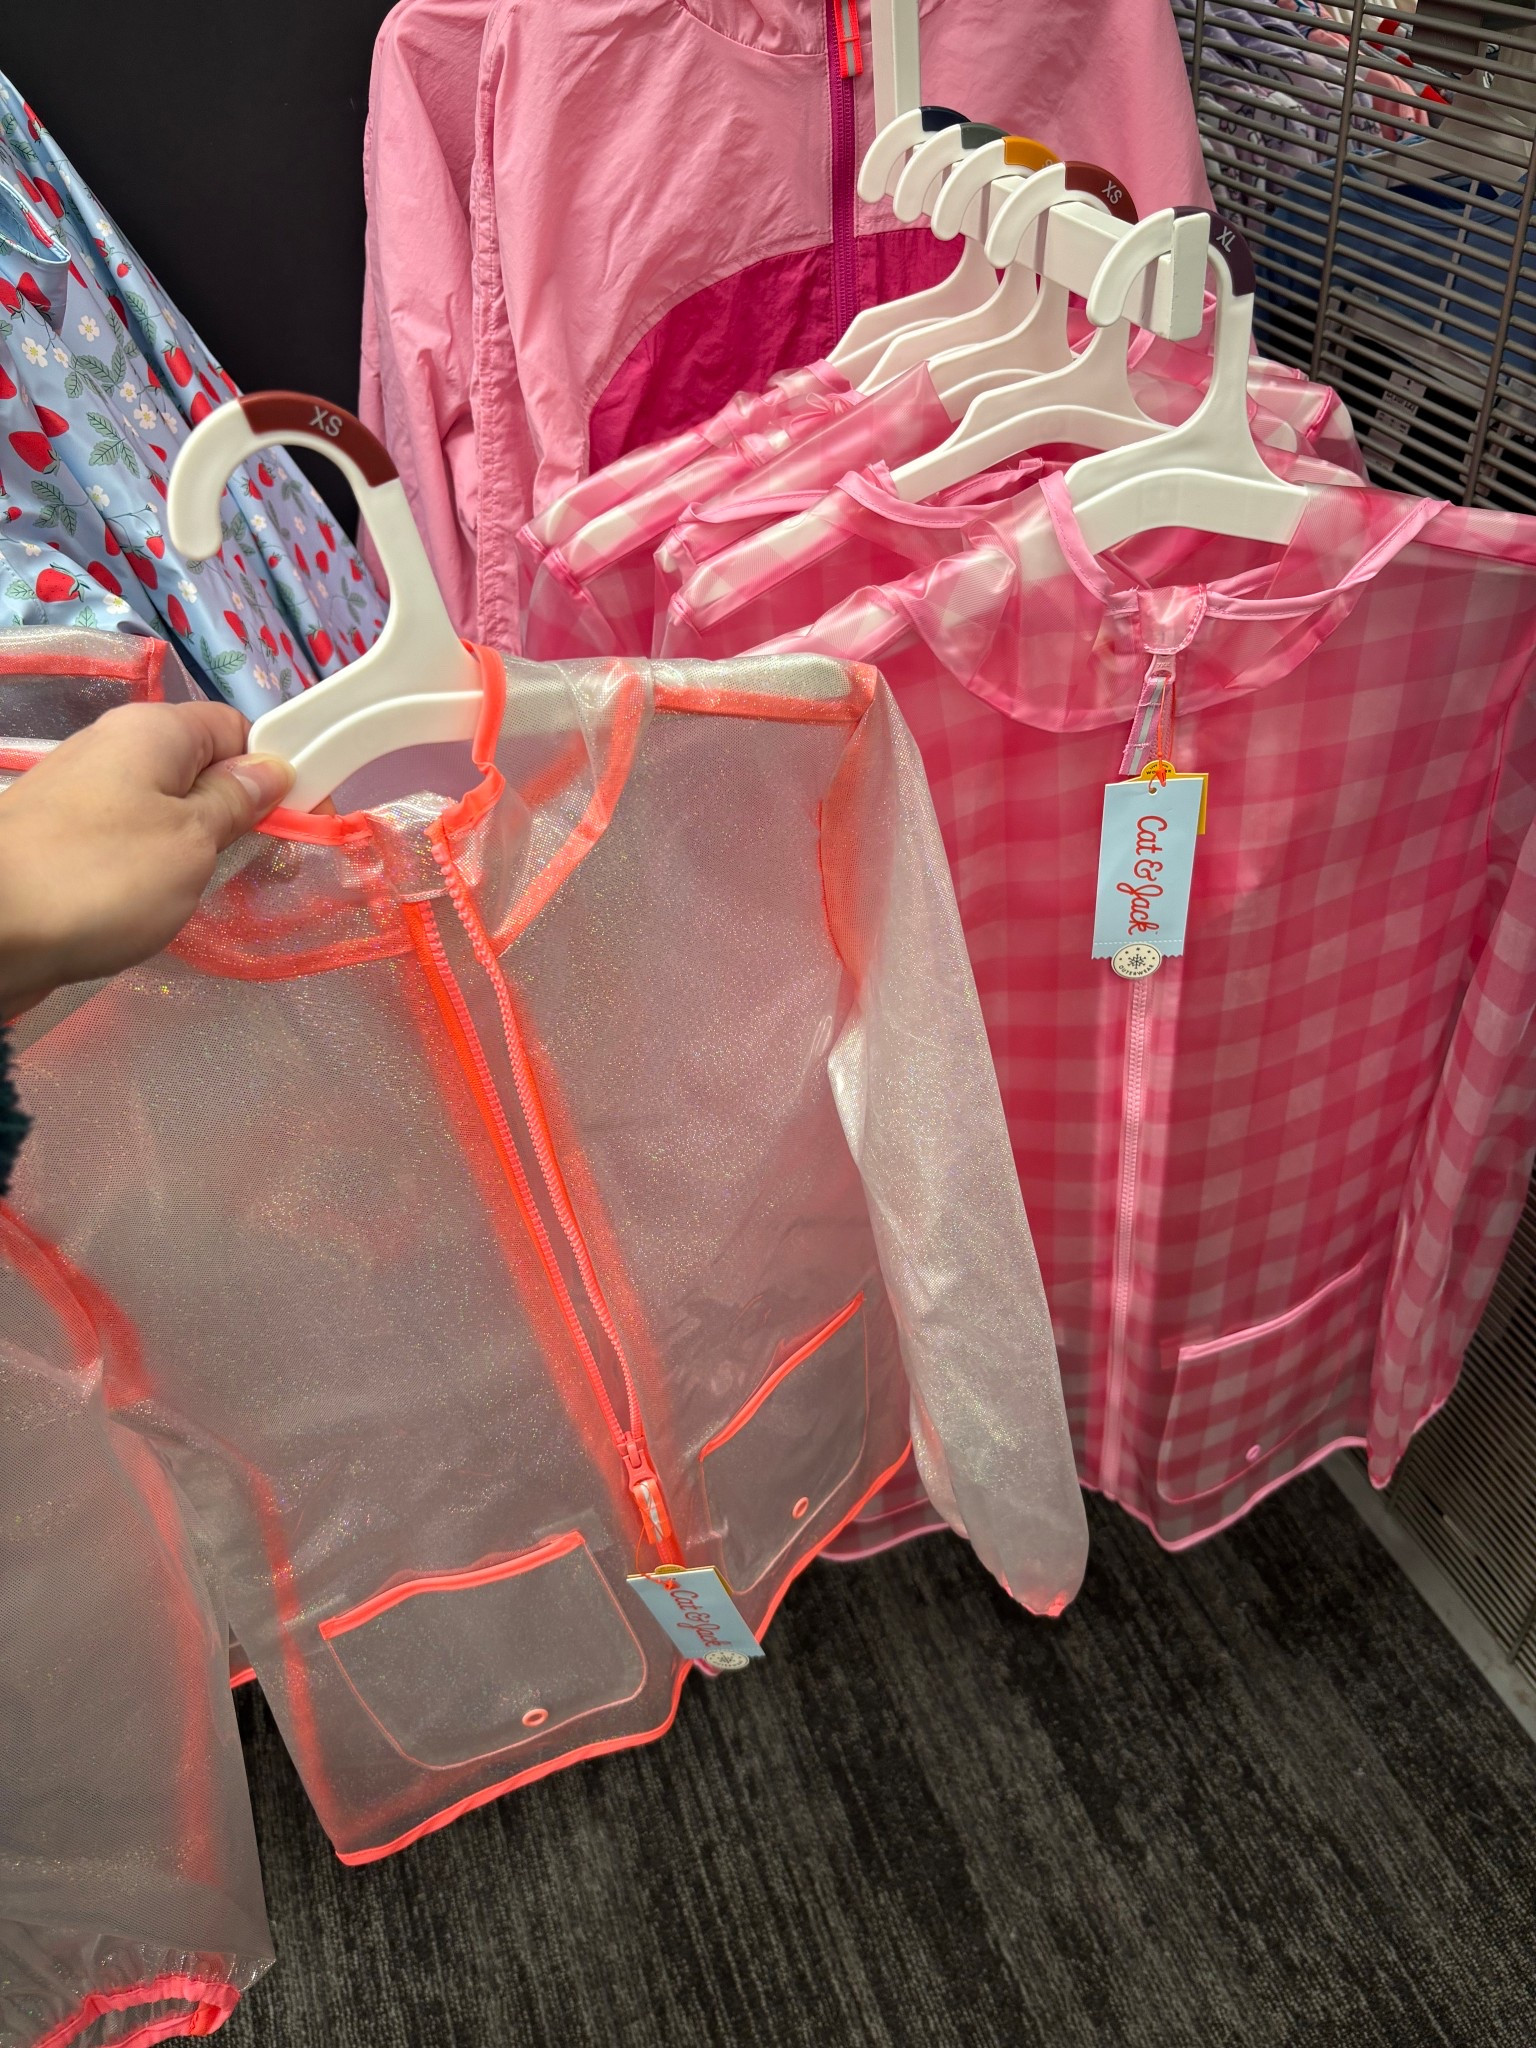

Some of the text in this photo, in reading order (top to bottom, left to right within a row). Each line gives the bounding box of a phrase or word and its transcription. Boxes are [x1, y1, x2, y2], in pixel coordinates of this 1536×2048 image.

[1101, 180, 1123, 205] XS
[1216, 225, 1236, 253] XL
[309, 406, 343, 437] XS
[1116, 815, 1168, 936] Cat & Jack
[1118, 964, 1155, 976] OUTERWEAR
[670, 1590, 704, 1611] Cat
[684, 1611, 711, 1623] &
[676, 1622, 732, 1648] Jack
